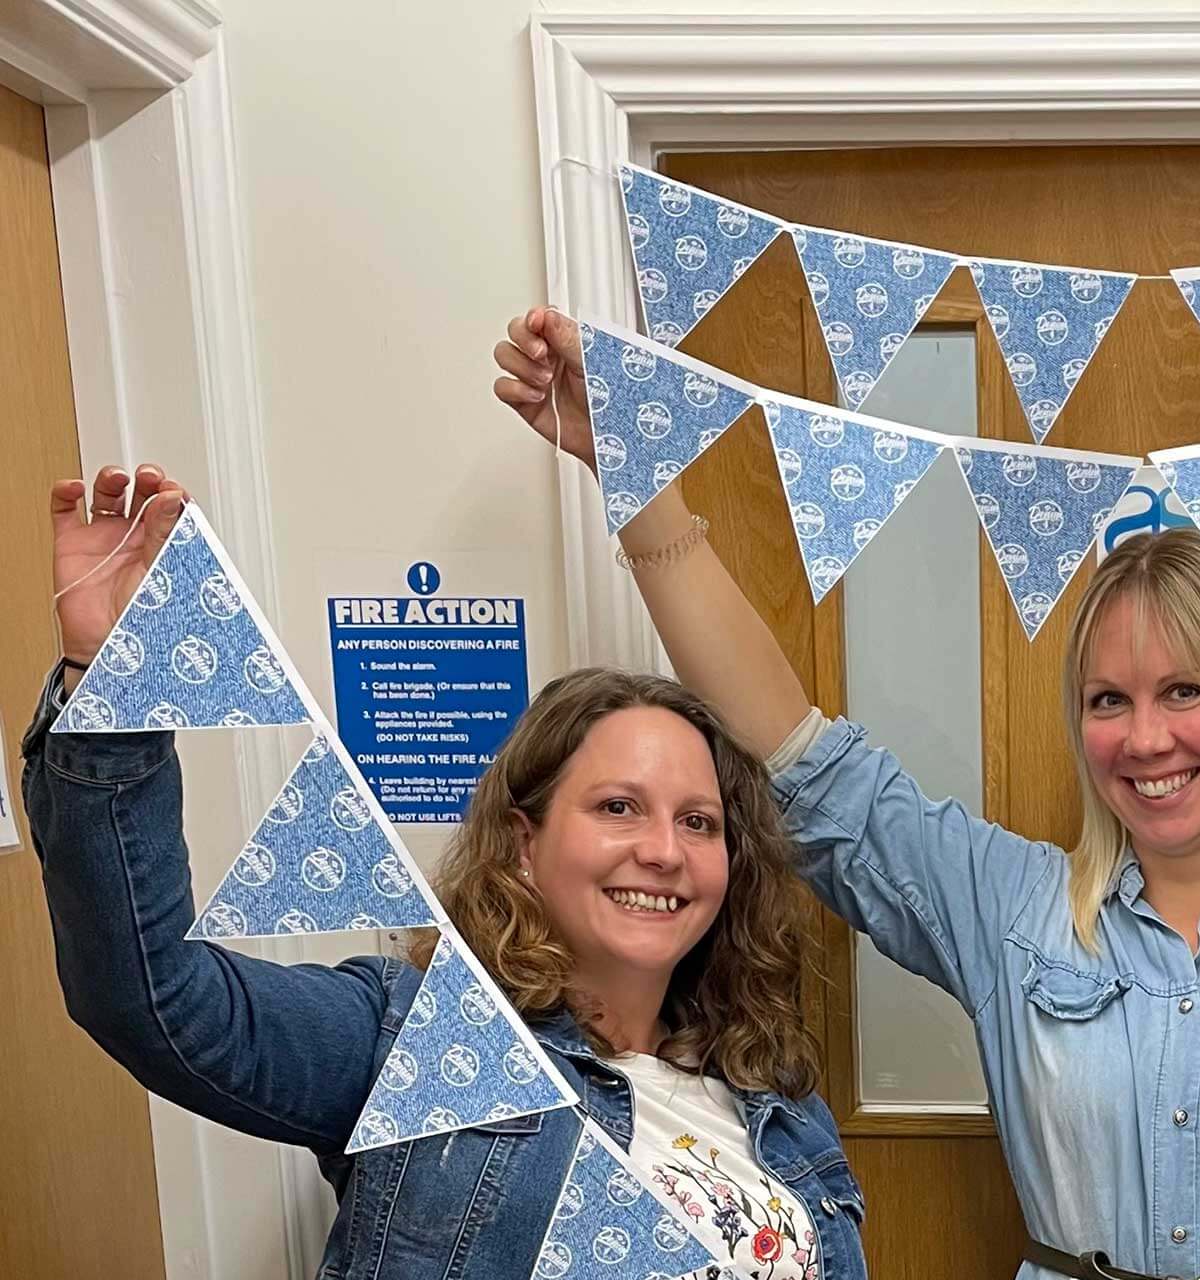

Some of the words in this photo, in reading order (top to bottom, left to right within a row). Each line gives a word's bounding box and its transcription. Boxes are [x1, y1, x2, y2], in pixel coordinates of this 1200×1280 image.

[335, 600, 399, 624] FIRE
[404, 600, 517, 624] ACTION
[338, 640, 360, 650] ANY
[361, 640, 407, 650] PERSON
[410, 640, 485, 650] DISCOVERING
[486, 640, 496, 650] A
[497, 640, 519, 650] FIRE
[370, 662, 397, 670] Sound
[398, 662, 410, 670] the
[361, 682, 369, 690] 2.
[372, 682, 388, 690] Call
[389, 682, 402, 690] fire
[437, 682, 450, 691] (Or
[480, 682, 495, 690] that
[497, 682, 511, 690] this
[363, 711, 370, 719] 3.
[374, 711, 400, 719] Attack
[401, 711, 413, 719] the
[415, 711, 428, 719] fire
[472, 711, 493, 720] using
[495, 711, 507, 719] the
[375, 720, 416, 729] appliances
[376, 733, 393, 743] (DO
[395, 734, 414, 742] NOT
[417, 734, 438, 742] TAKE
[440, 733, 469, 743] RISKS)
[357, 755, 374, 764] ON
[376, 755, 426, 764] HEARING
[428, 755, 450, 764] THE
[452, 755, 476, 764] FIRE
[404, 777, 435, 785] building
[436, 777, 446, 785] by
[451, 787, 465, 795] any
